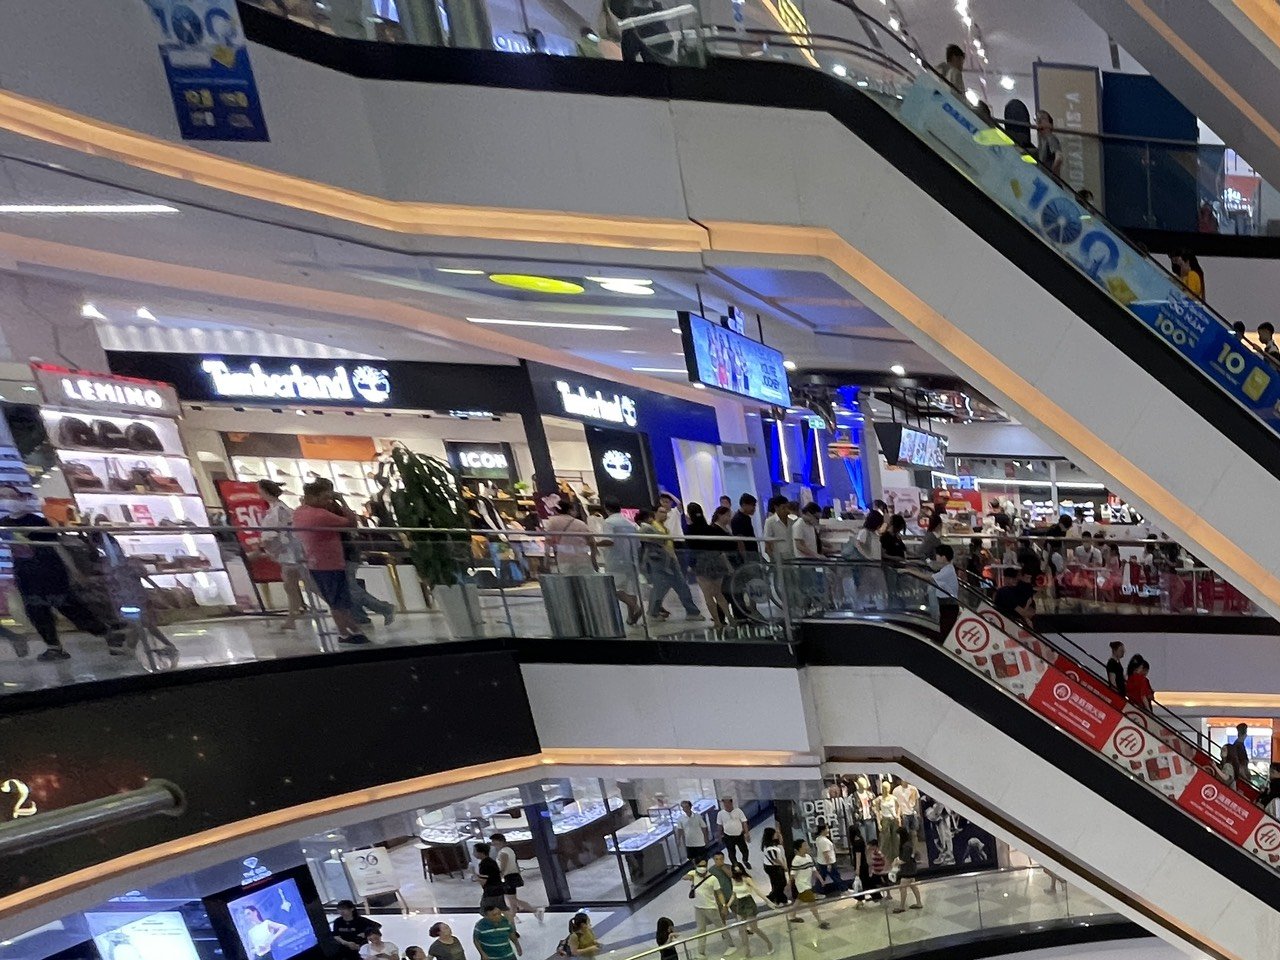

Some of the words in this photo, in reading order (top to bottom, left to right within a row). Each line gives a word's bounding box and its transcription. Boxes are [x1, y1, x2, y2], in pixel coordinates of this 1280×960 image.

[1217, 342, 1246, 375] 10
[61, 377, 163, 409] LEMINO
[201, 359, 354, 400] Timberland
[458, 451, 508, 469] ICON
